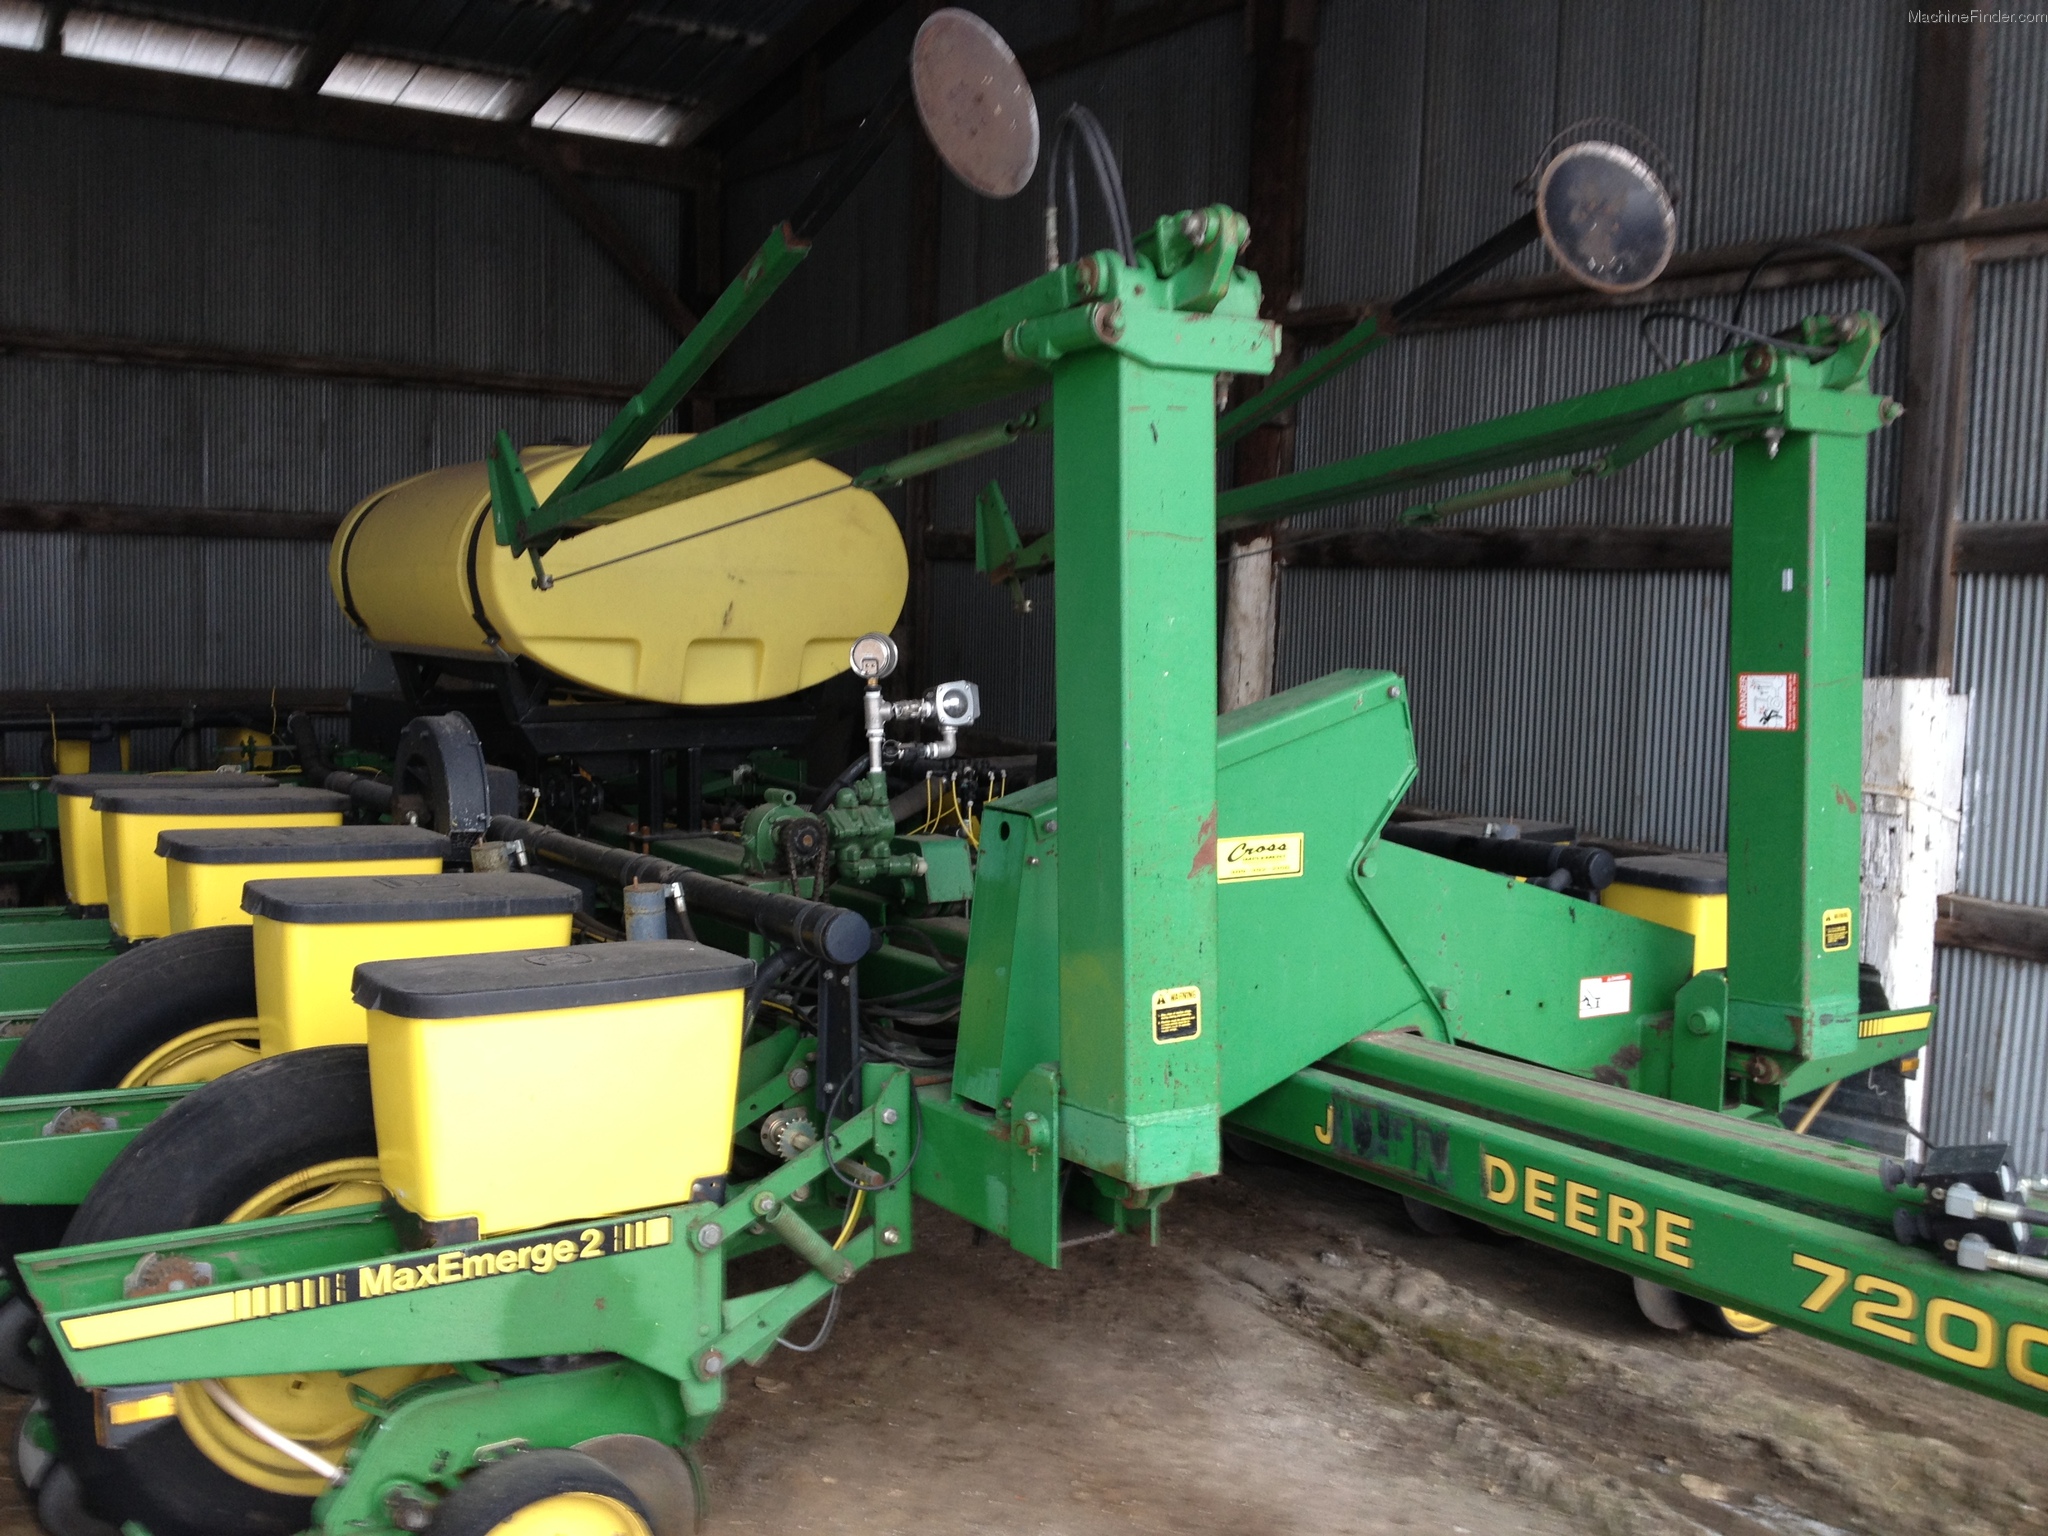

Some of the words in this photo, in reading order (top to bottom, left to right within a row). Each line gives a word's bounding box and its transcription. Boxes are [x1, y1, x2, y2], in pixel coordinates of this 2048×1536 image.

[1227, 842, 1287, 863] Cross
[1484, 1153, 1694, 1269] DEERE
[359, 1239, 578, 1298] MaxEmerge
[580, 1228, 605, 1259] 2
